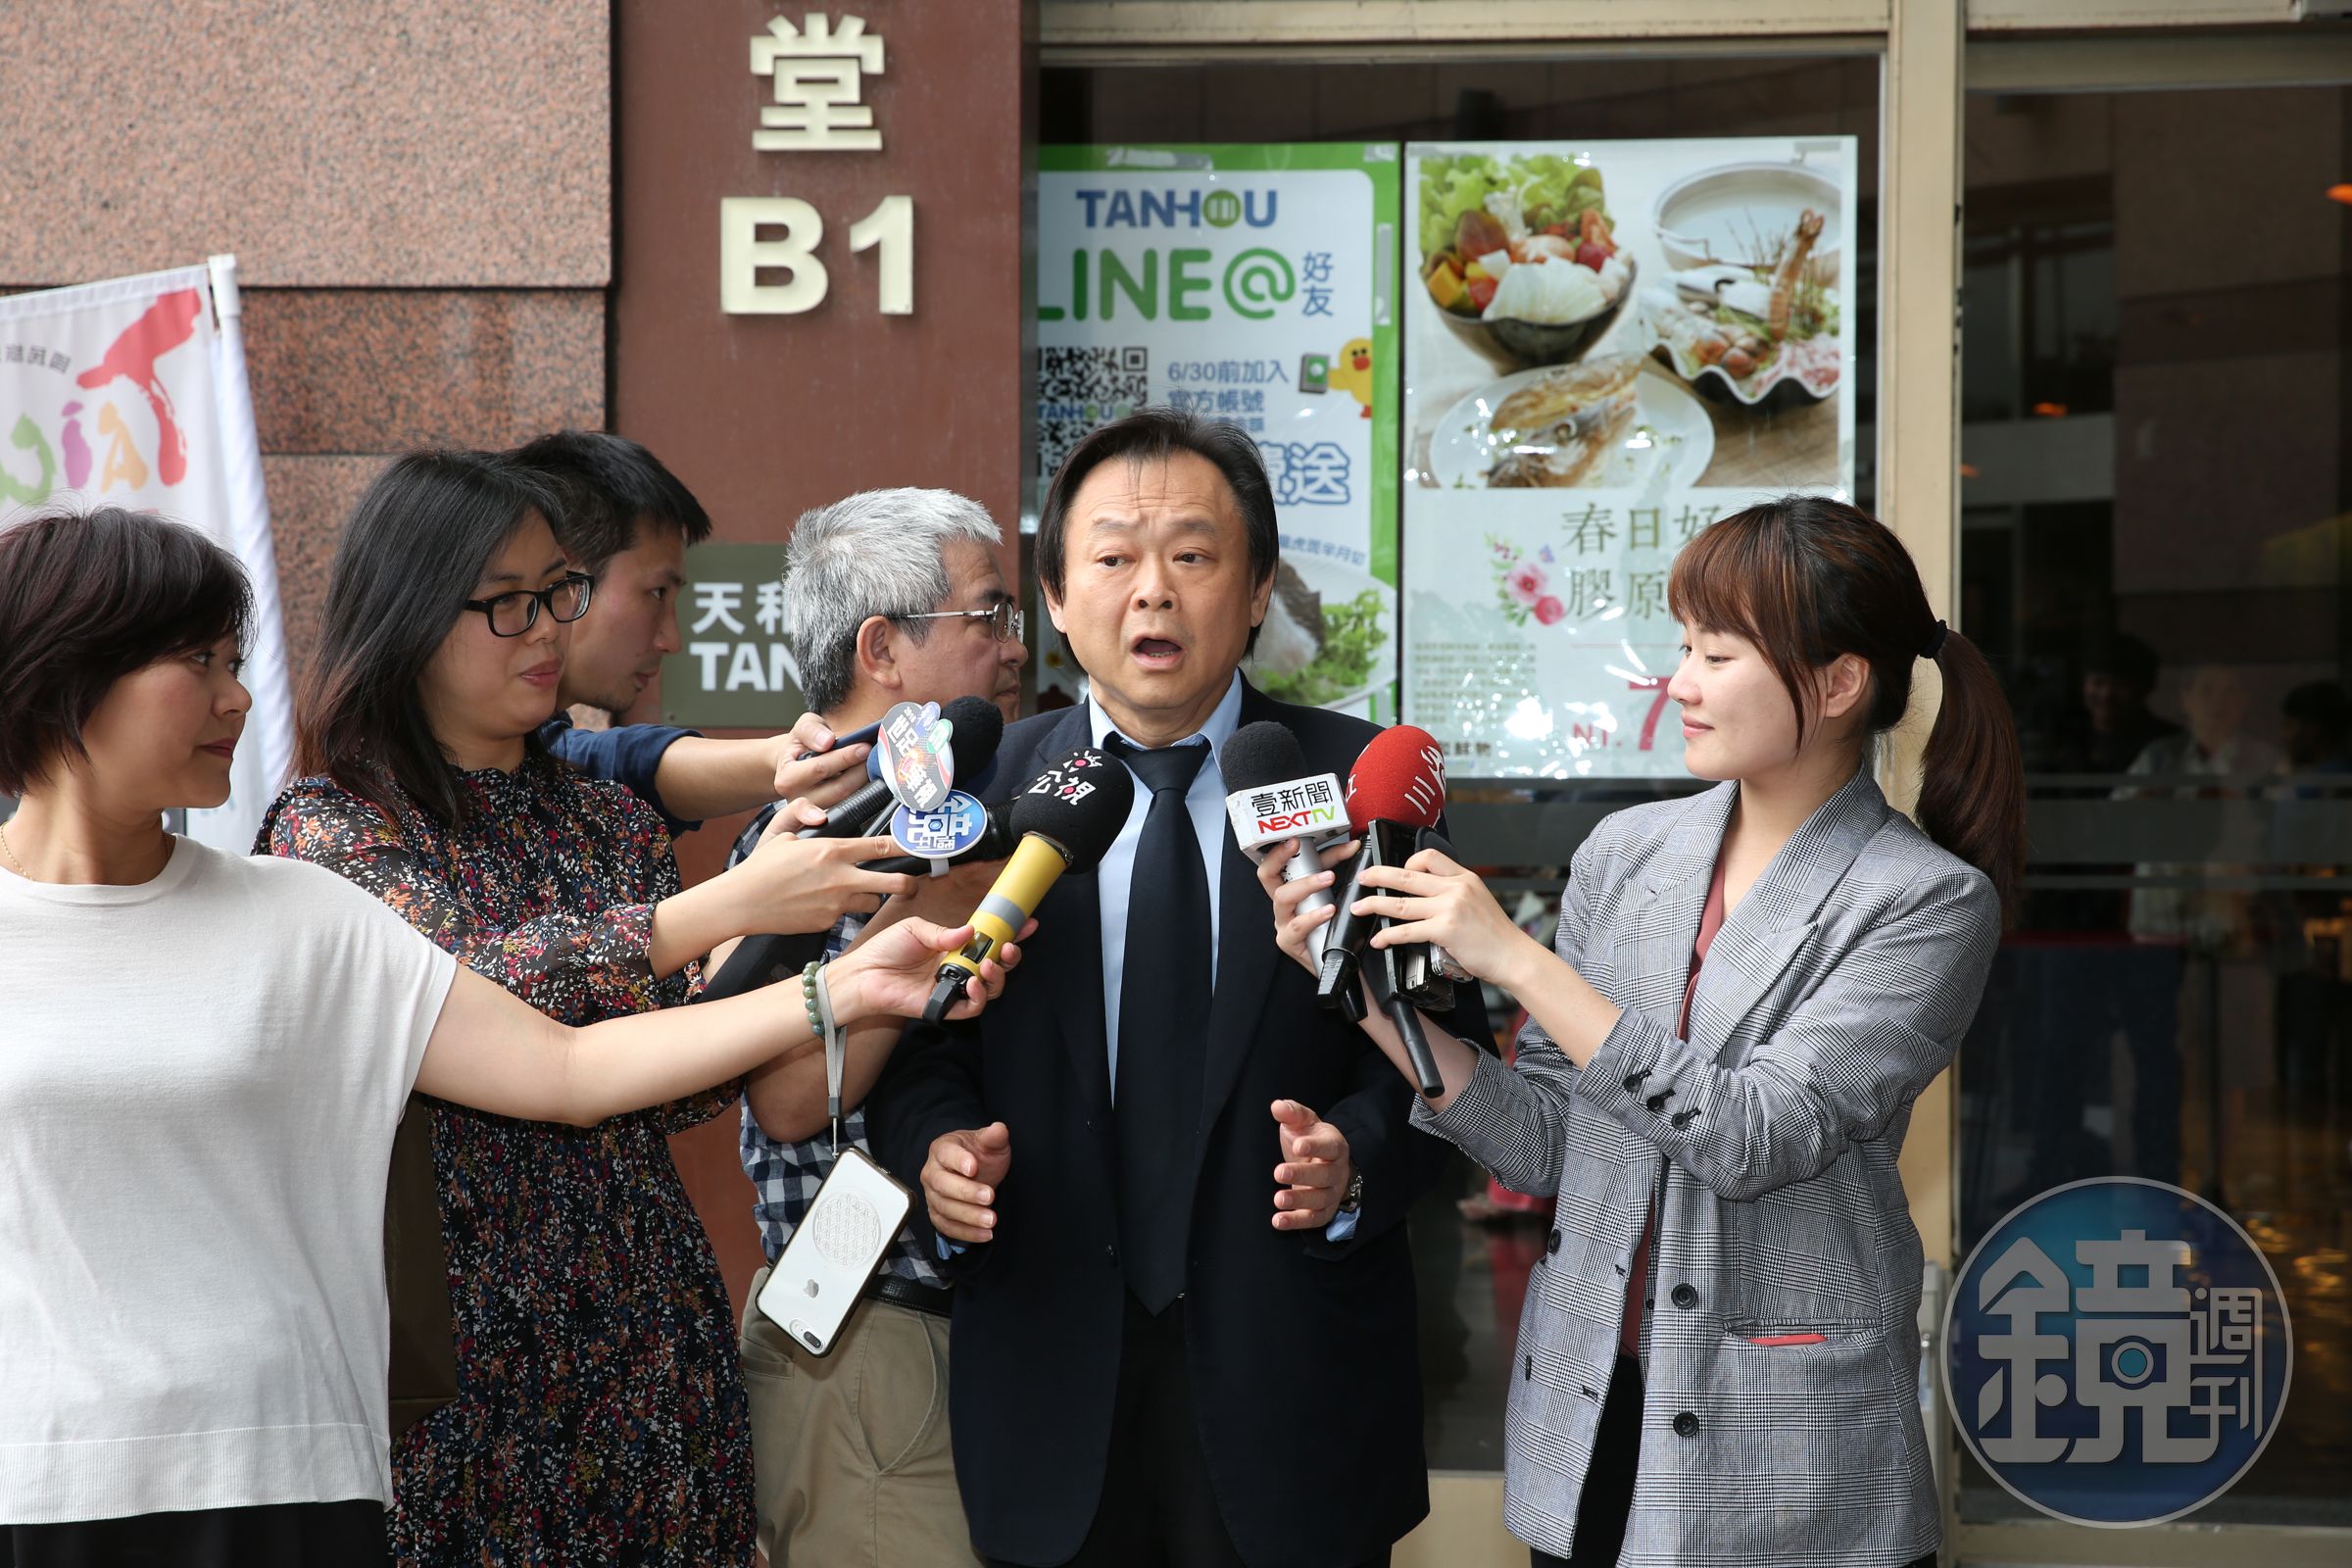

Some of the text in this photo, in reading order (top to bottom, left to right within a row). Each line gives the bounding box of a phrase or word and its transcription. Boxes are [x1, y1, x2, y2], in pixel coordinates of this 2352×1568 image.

[750, 13, 884, 151] 堂
[1076, 189, 1278, 228] TANHOU
[720, 196, 913, 315] B1
[1301, 251, 1334, 318] 好友
[1167, 360, 1289, 383] 6/30前加入
[1028, 768, 1097, 807] 公視
[1250, 780, 1333, 818] 壹新聞
[1257, 806, 1335, 834] NEXTTV
